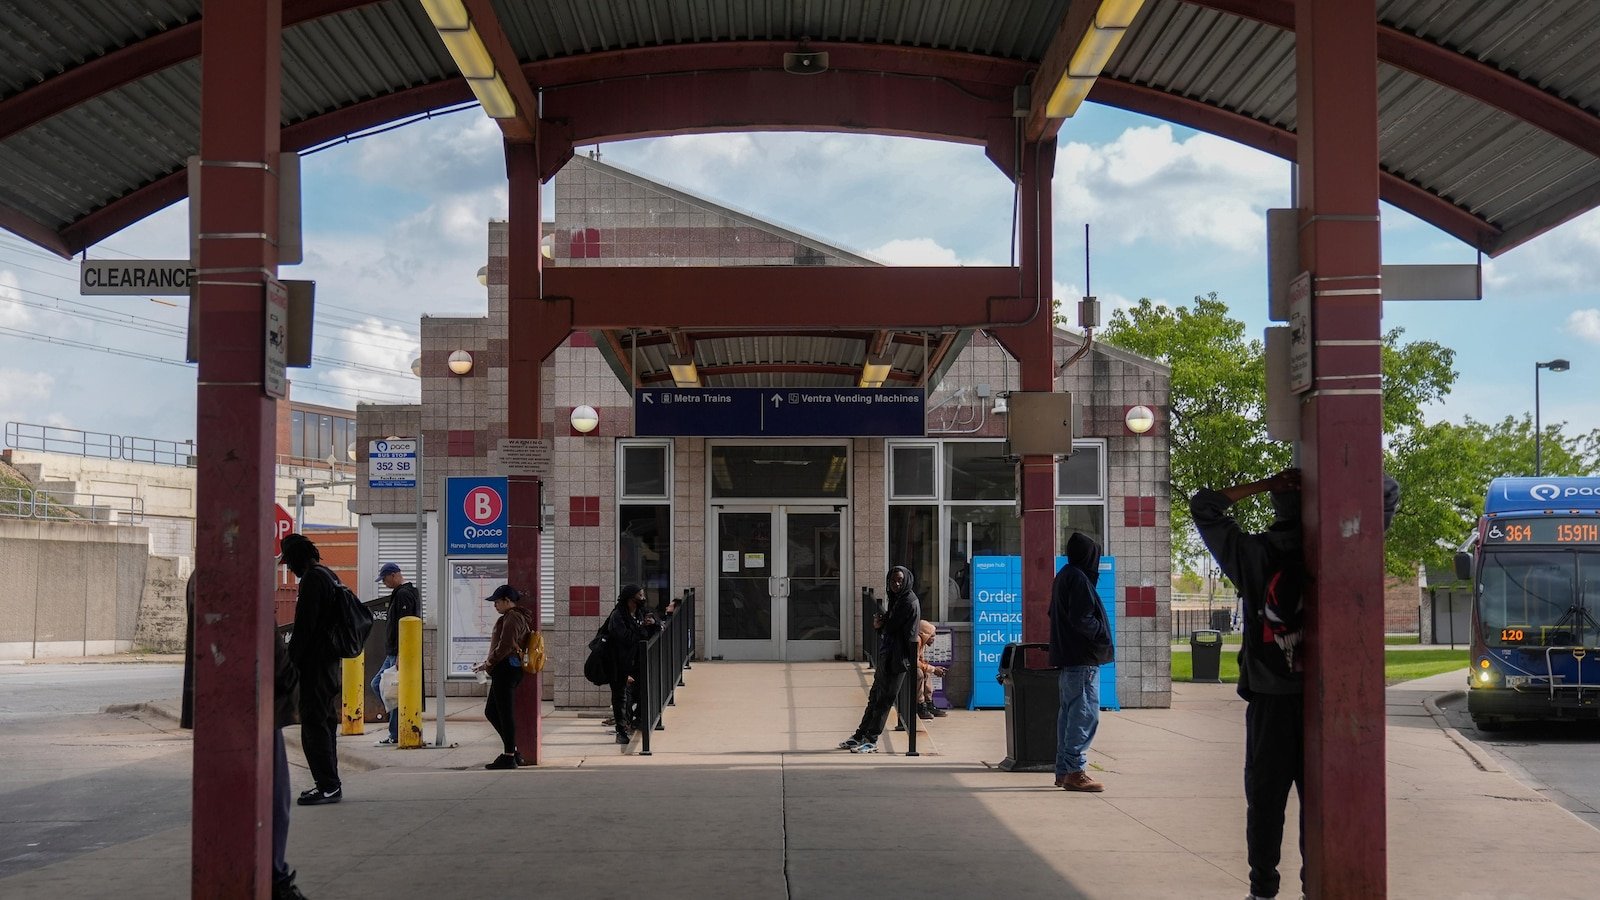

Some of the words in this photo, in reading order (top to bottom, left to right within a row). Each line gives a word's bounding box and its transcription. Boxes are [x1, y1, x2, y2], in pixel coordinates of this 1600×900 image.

[84, 267, 196, 288] CLEARANCE
[674, 394, 701, 403] Metra
[703, 394, 732, 403] Trains
[801, 394, 832, 403] Ventra
[834, 394, 872, 405] Vending
[874, 394, 920, 403] Machines
[376, 461, 393, 471] 352
[396, 461, 411, 471] SB
[475, 493, 492, 519] B
[477, 529, 503, 537] pace
[1505, 525, 1532, 542] 364
[1557, 525, 1598, 542] 159TH
[455, 565, 473, 575] 352
[978, 590, 1017, 603] Order
[978, 630, 1005, 645] pick
[1501, 629, 1524, 641] 120
